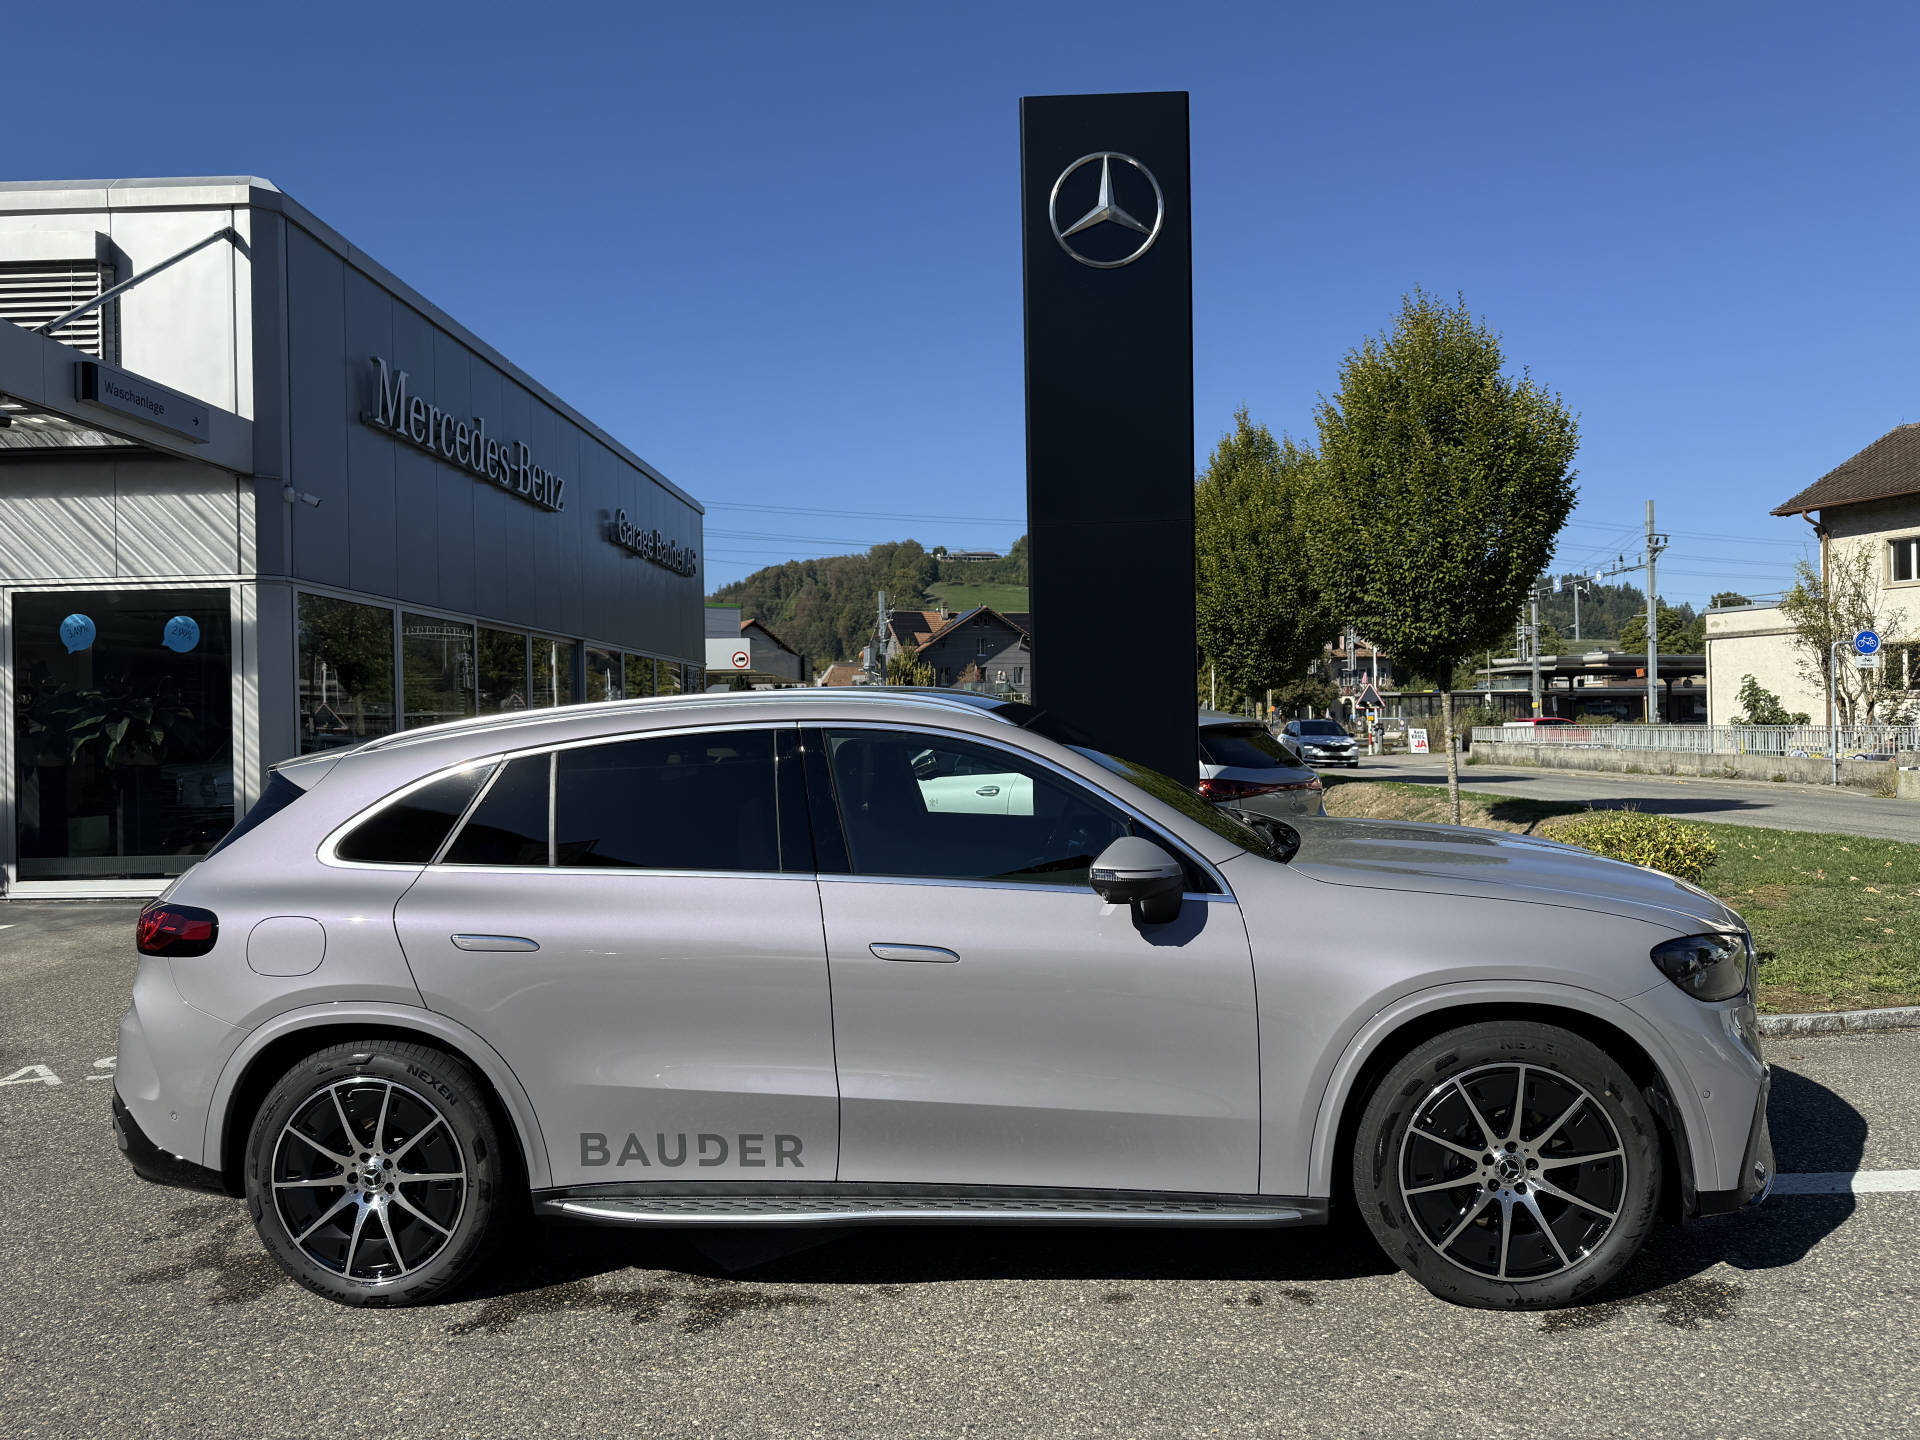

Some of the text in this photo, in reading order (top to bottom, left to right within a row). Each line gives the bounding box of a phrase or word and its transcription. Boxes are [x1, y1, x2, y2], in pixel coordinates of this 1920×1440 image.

[104, 381, 166, 416] Waschanlage
[375, 356, 566, 512] Mercedes-Benz
[618, 508, 655, 560] Garage
[656, 530, 684, 574] Bauder
[1414, 739, 1427, 748] JA
[406, 1063, 457, 1107] NEXEN
[579, 1132, 805, 1168] BAUDER
